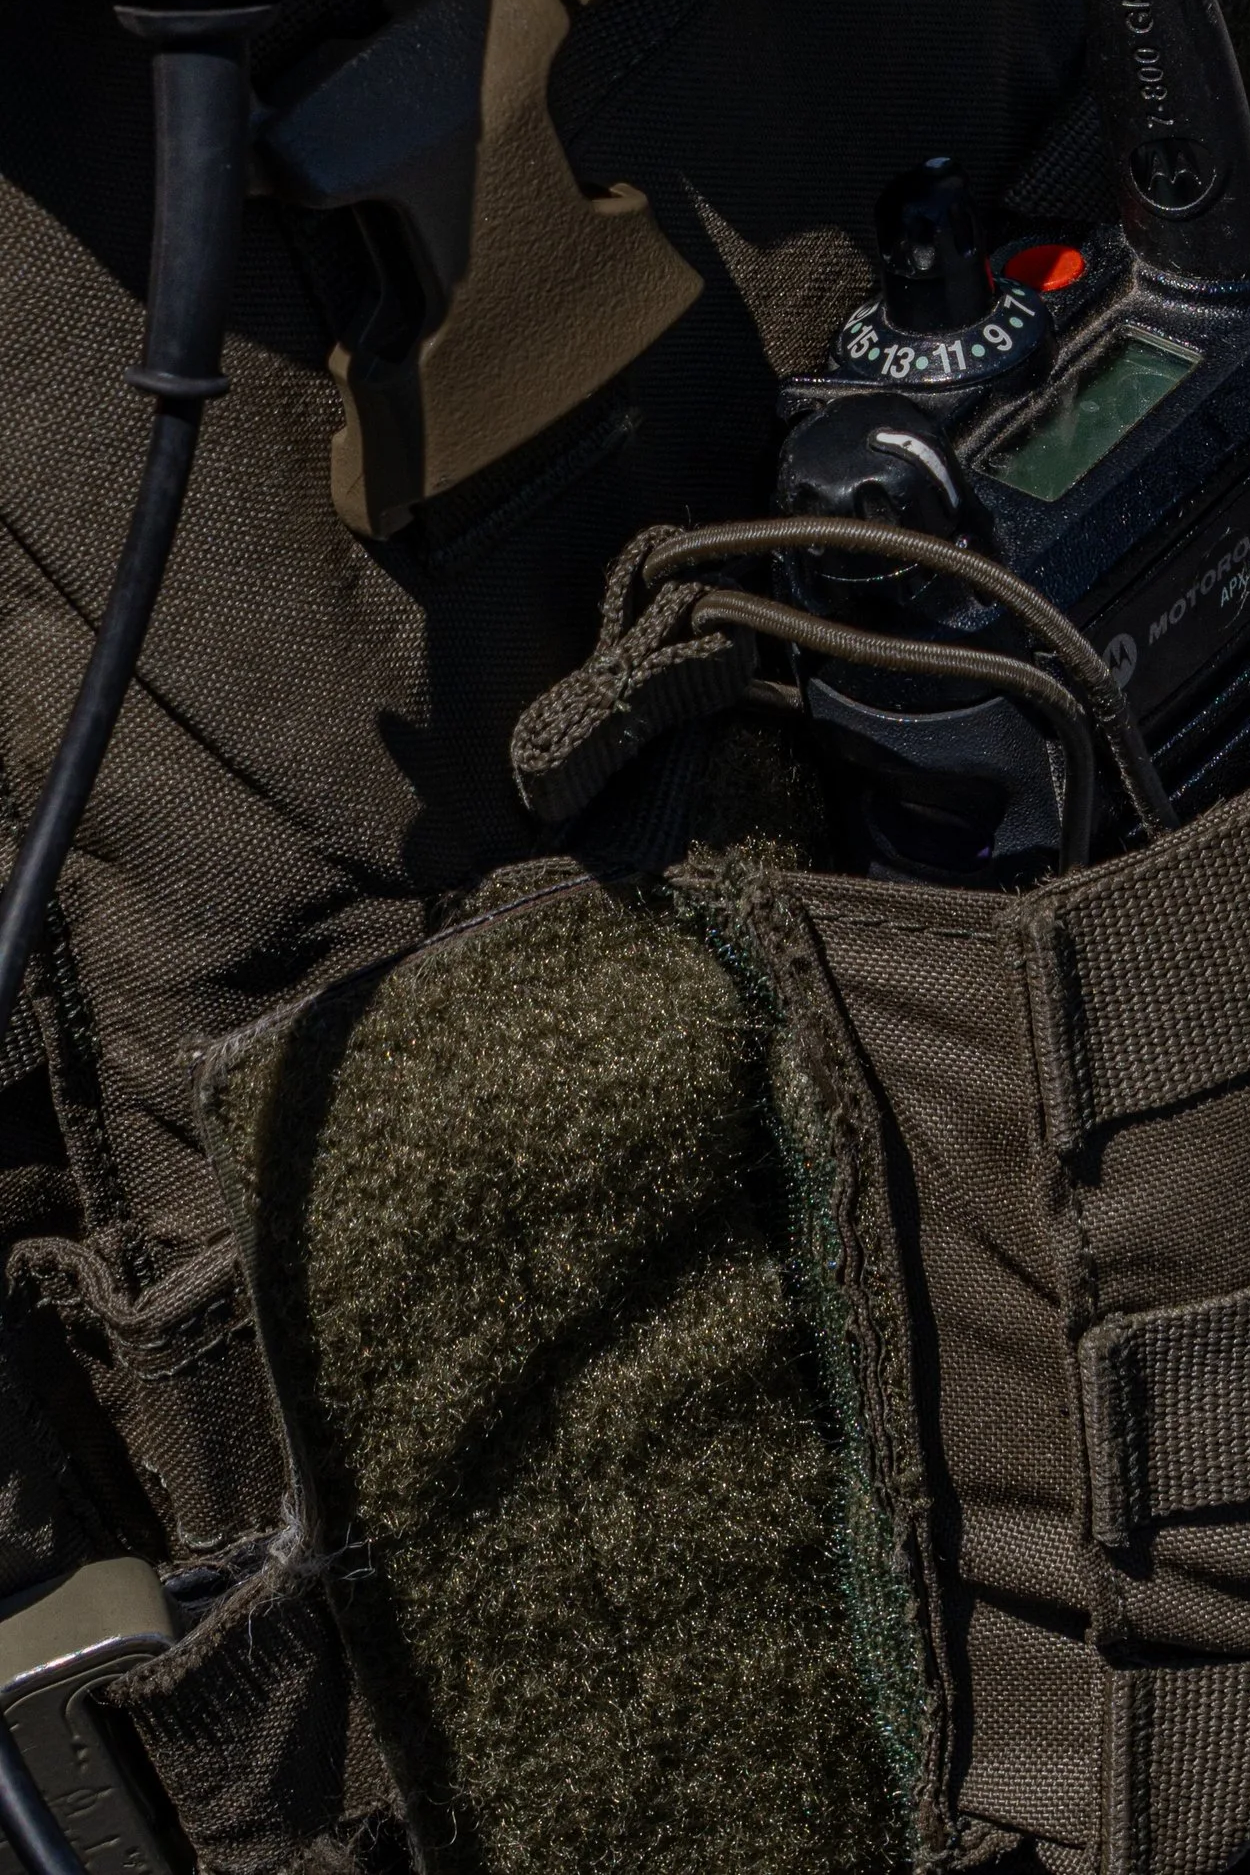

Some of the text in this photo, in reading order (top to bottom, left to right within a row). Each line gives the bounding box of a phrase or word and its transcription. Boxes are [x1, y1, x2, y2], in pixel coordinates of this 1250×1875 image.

[846, 293, 1037, 379] 15 13 11 9 7
